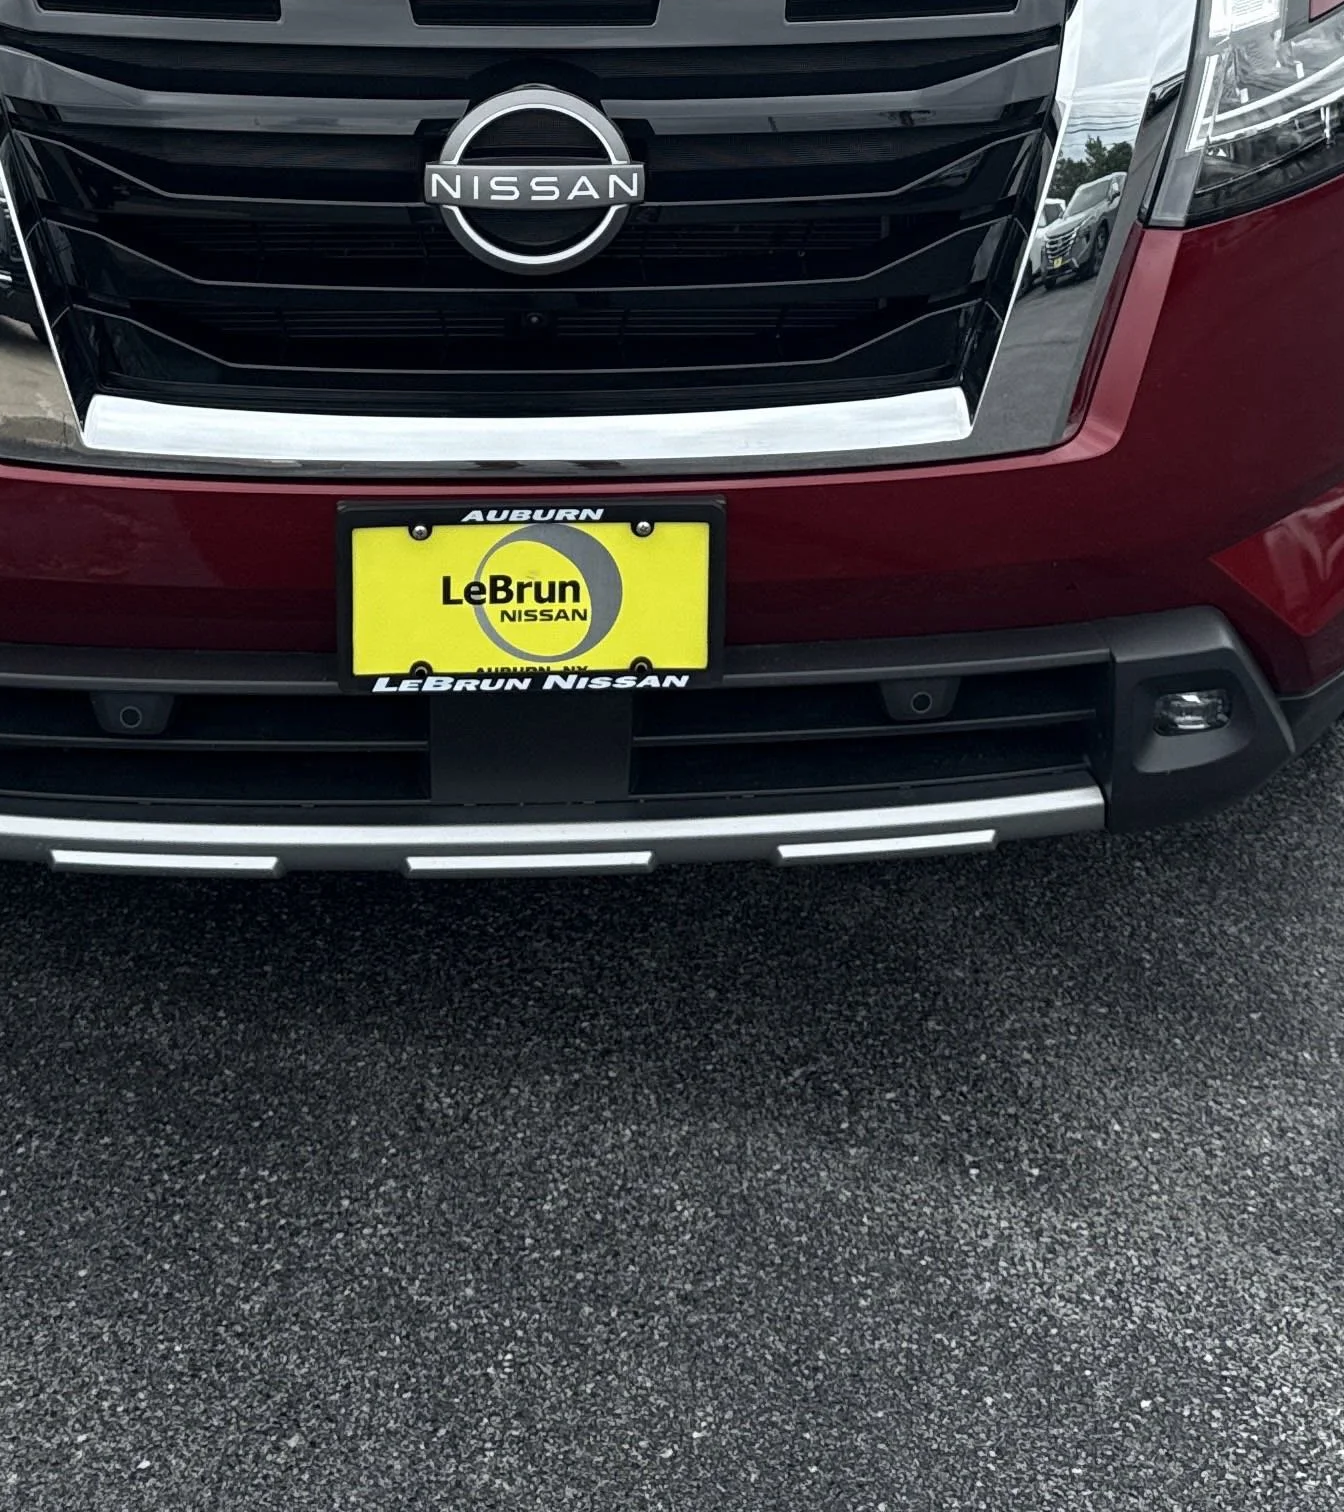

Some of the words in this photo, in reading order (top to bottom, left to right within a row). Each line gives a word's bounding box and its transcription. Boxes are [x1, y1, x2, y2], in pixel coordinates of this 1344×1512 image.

[431, 172, 639, 201] NISSAN
[460, 507, 605, 523] AUBURN
[442, 574, 581, 605] LeBrun
[499, 608, 588, 623] NISSAN
